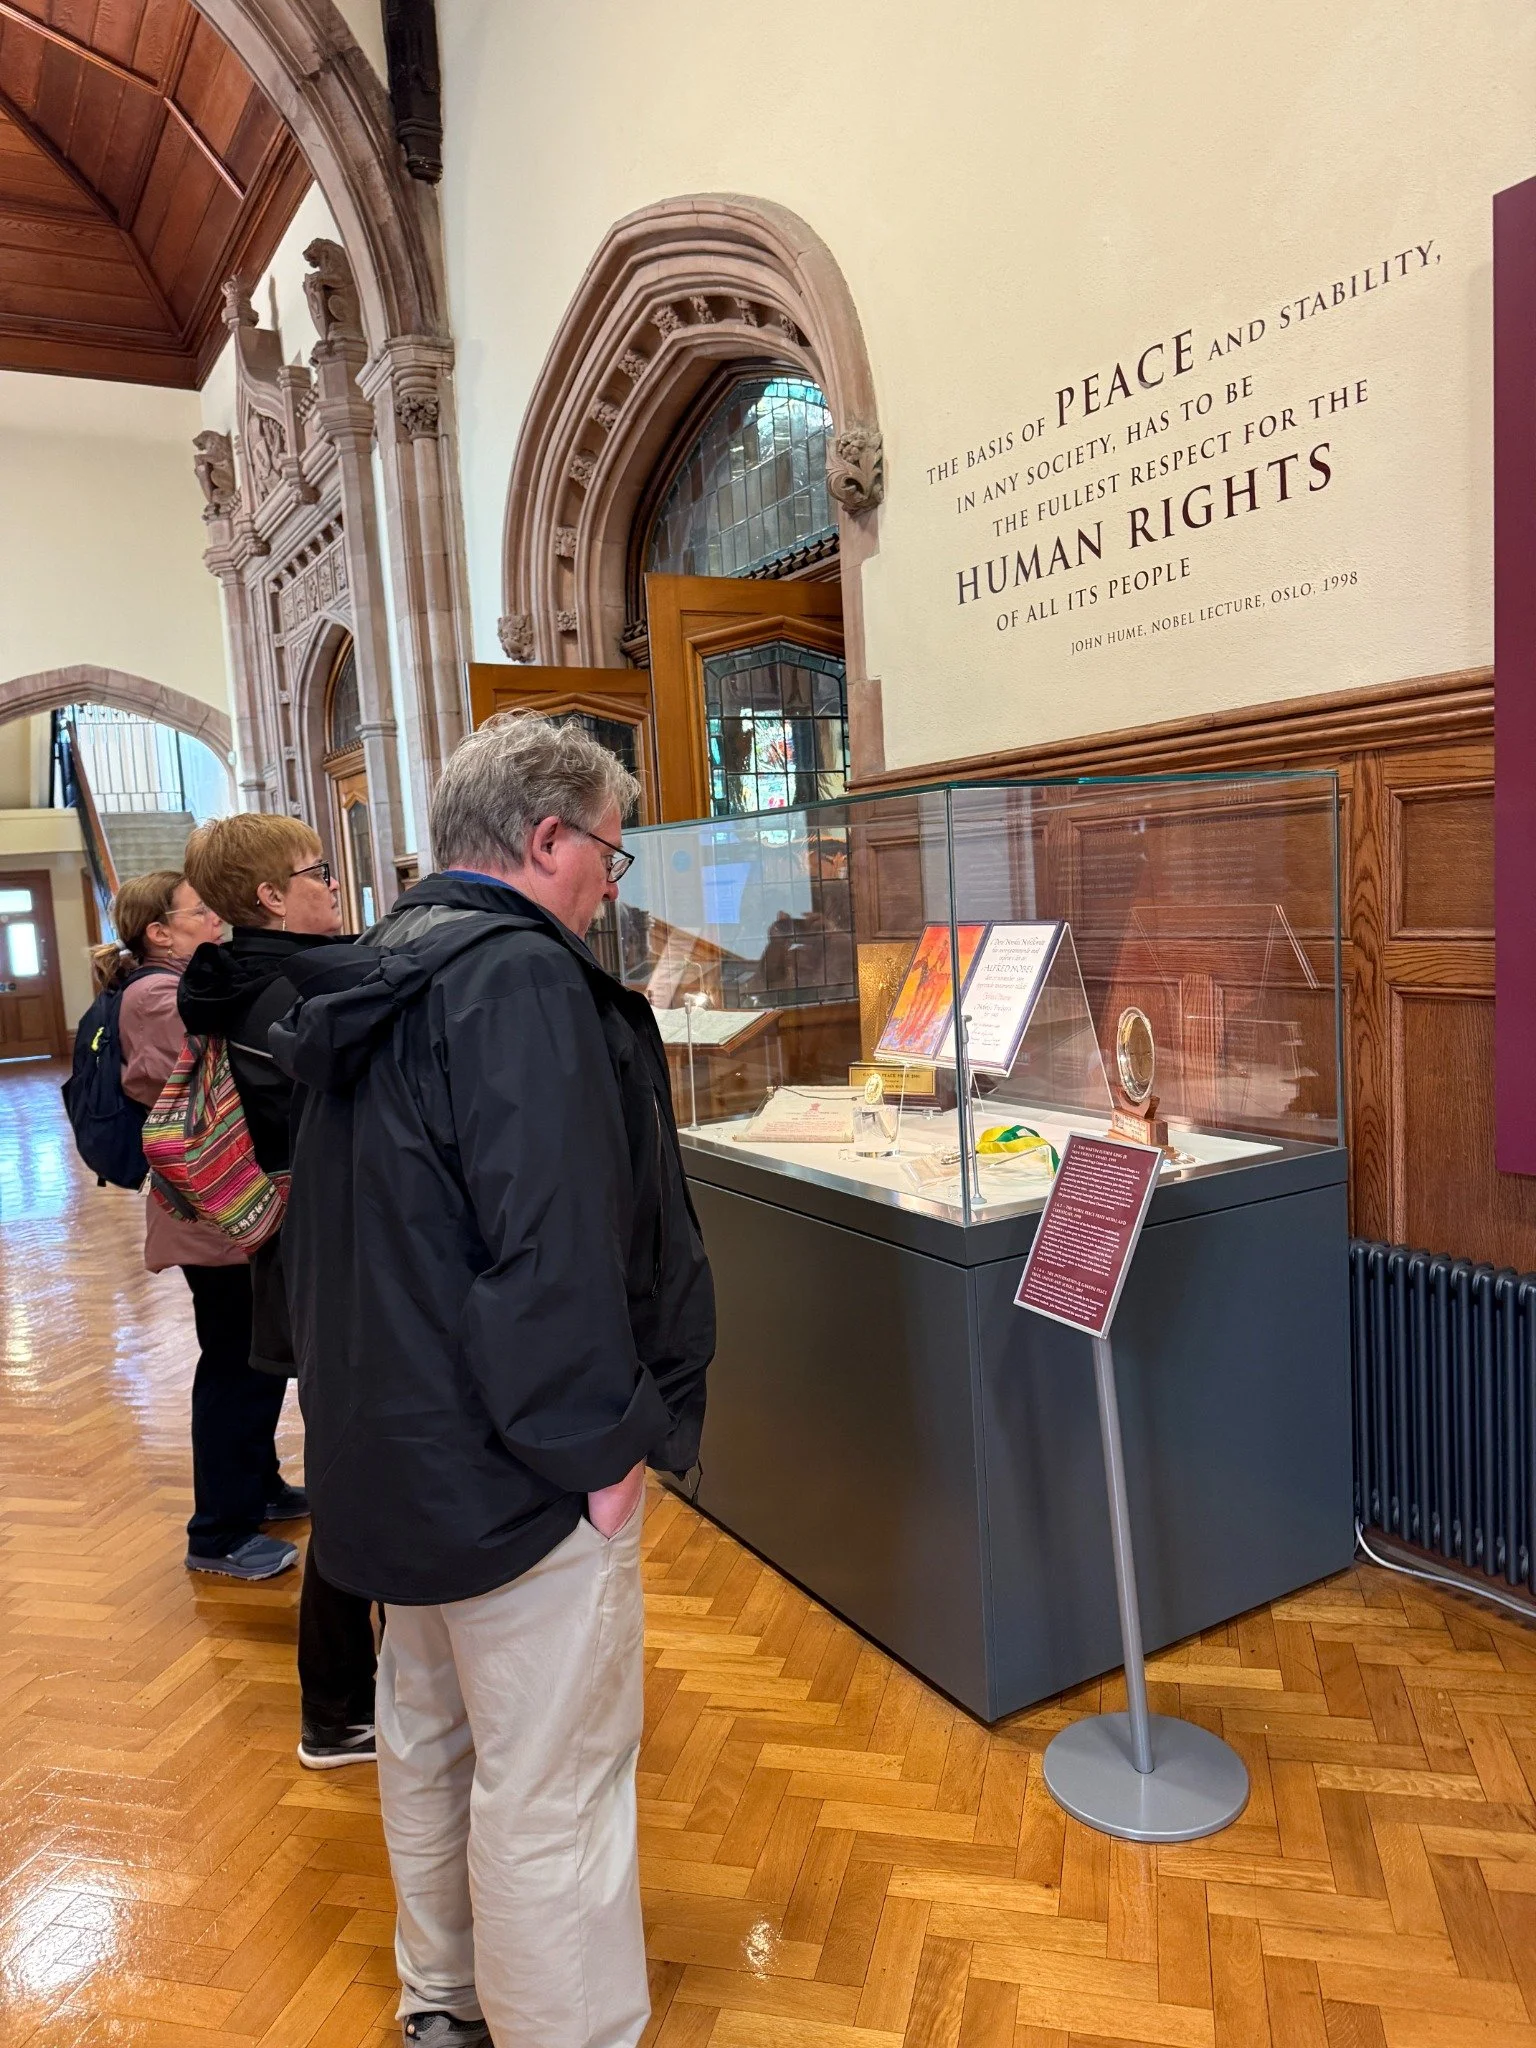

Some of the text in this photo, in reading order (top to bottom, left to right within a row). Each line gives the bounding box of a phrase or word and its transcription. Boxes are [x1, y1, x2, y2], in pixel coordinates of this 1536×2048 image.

[926, 239, 1441, 485] THE BASIS OF PEACE AND STABILITY,
[956, 374, 1253, 514] IN ANY SOCIETY, HAS TO BE
[992, 378, 1368, 537] THE FULLEST RESPECT FOR THE
[955, 442, 1331, 605] HUMAN RIGHTS
[996, 556, 1190, 631] OF ALL ITS PEOPLE
[1071, 570, 1357, 655] JOHN HUME, NOBEL LECTURE, OSLO, 1998
